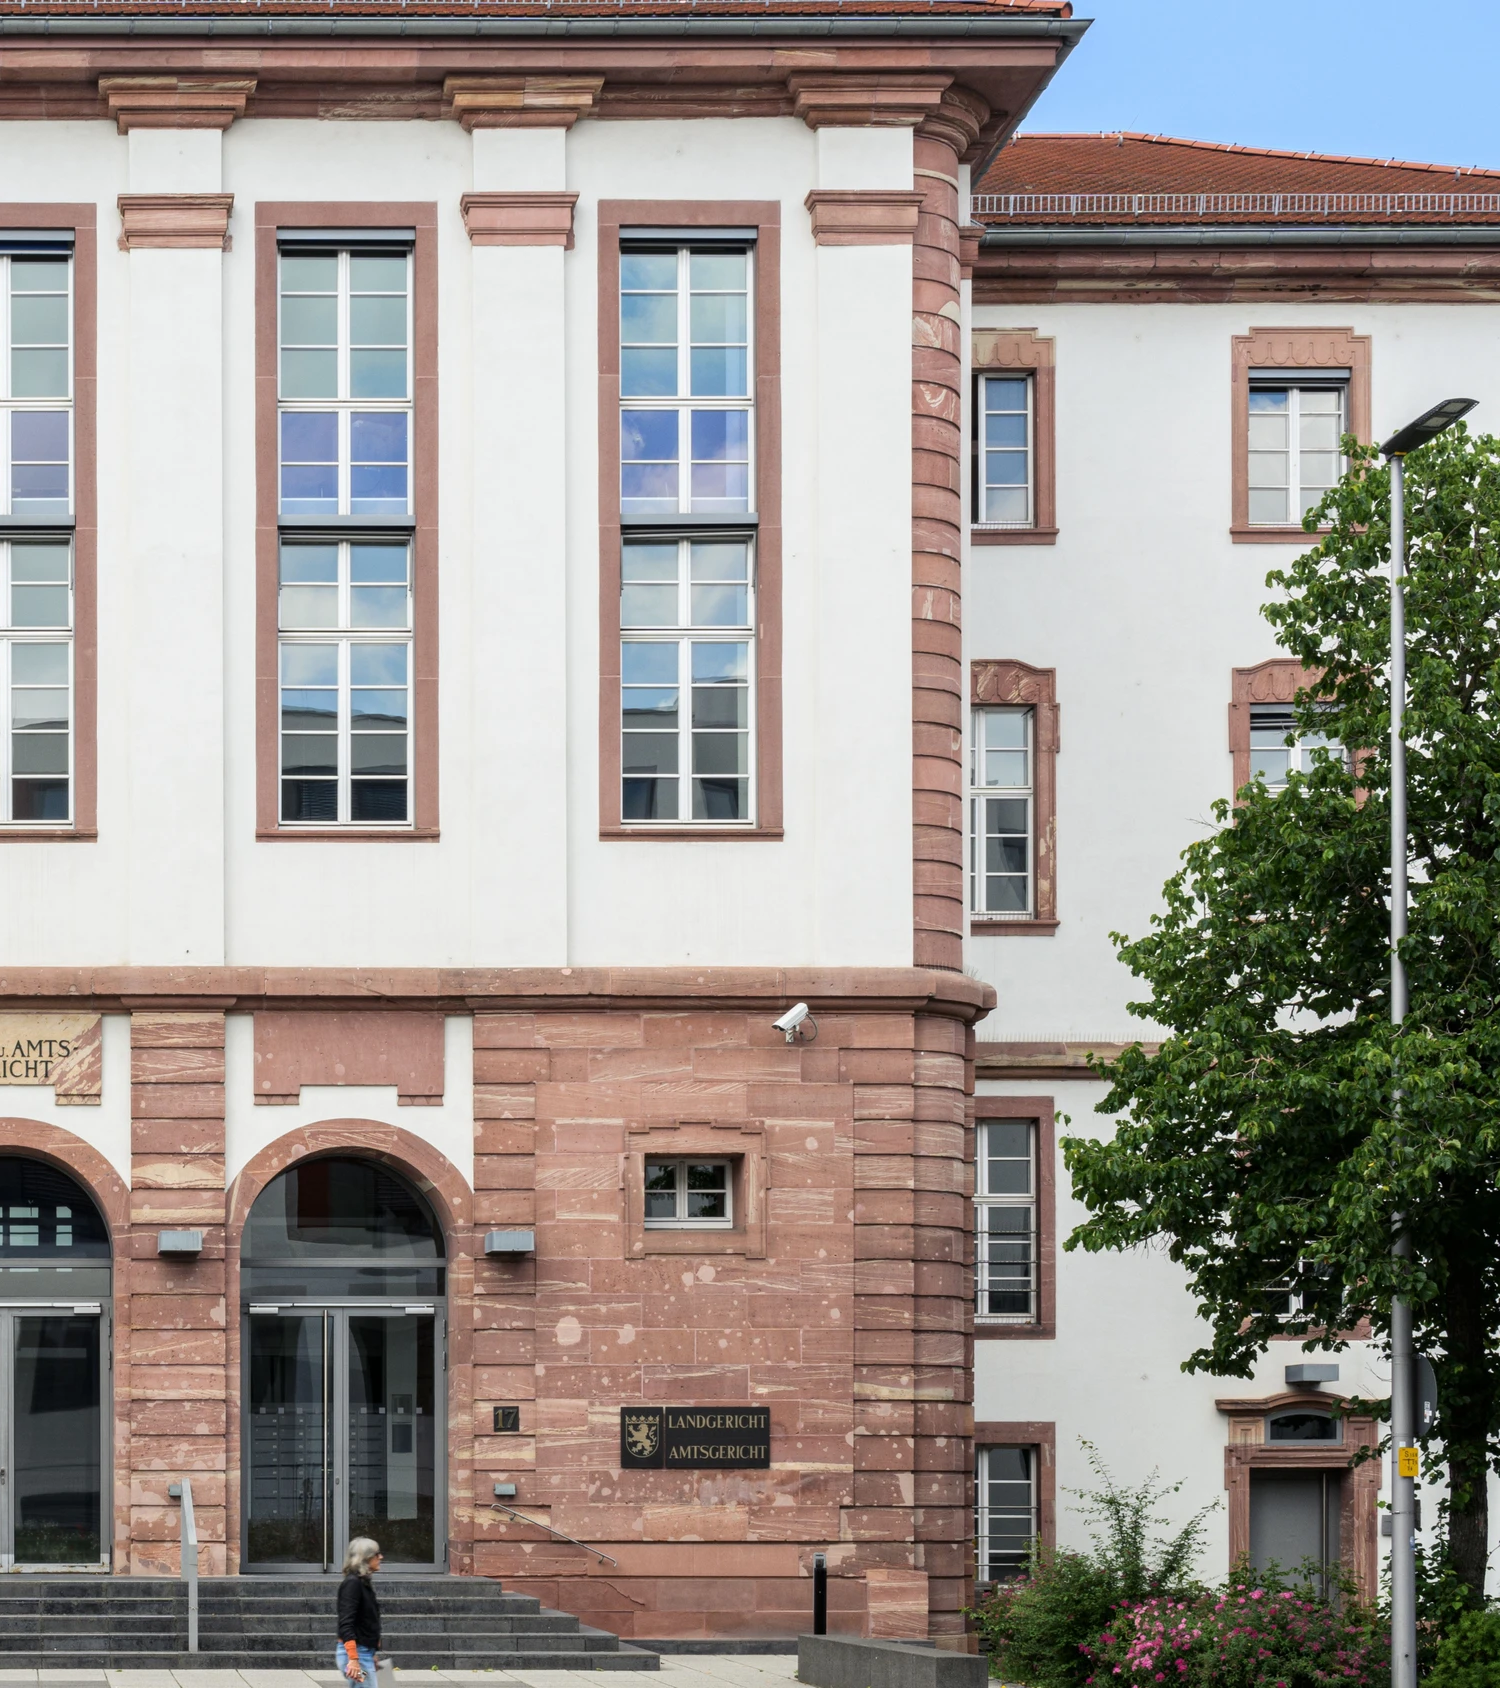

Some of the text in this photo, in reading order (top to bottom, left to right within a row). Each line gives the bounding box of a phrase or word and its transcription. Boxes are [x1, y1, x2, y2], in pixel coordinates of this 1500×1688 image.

[495, 1409, 517, 1429] 17
[668, 1414, 767, 1429] LANDGERICHT
[668, 1445, 767, 1459] AMTSGERICHT
